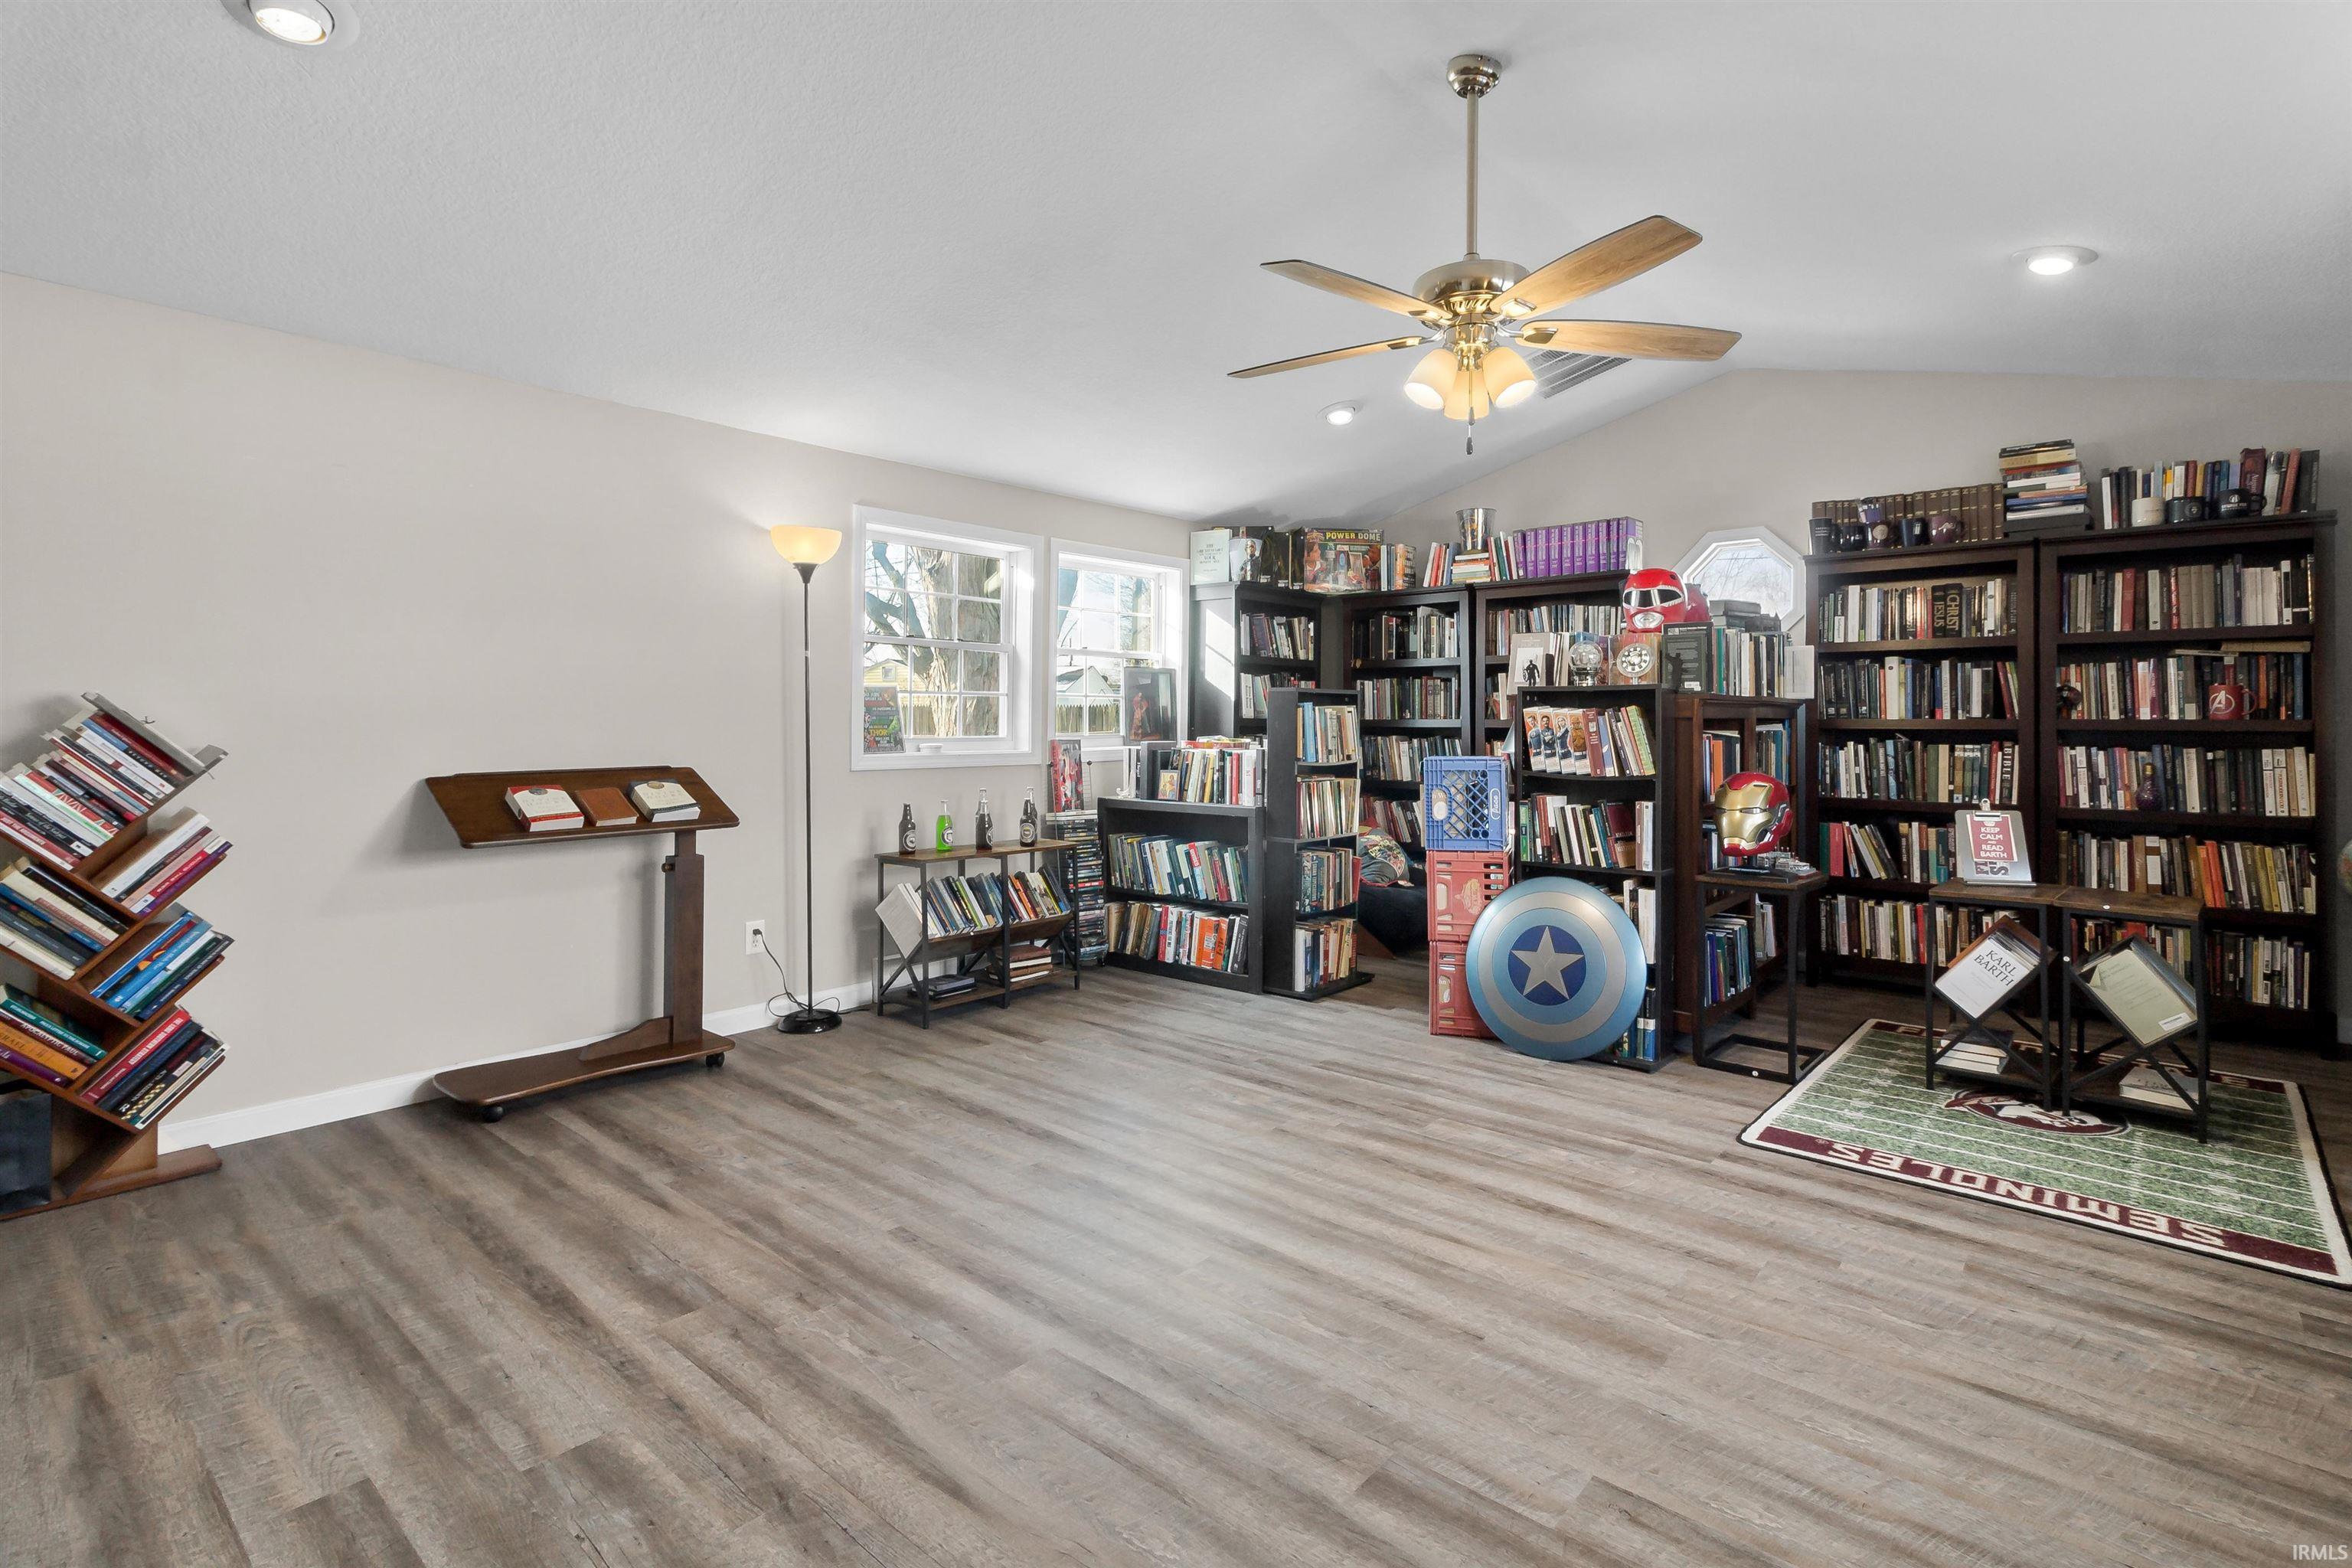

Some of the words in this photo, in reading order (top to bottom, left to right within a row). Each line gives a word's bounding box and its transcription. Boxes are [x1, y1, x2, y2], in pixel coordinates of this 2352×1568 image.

[1325, 531, 1355, 540] POWER
[1358, 532, 1381, 541] DOME
[1934, 602, 1943, 626] JESUS
[1946, 594, 1958, 630] CHRIST
[2003, 747, 2012, 779] BIBLE
[1974, 955, 2014, 986] BARTH
[1986, 950, 2017, 976] KARL
[21, 1022, 63, 1047] APOCALYPTIC
[62, 1042, 80, 1056] PAUL
[1828, 1142, 2228, 1248] SEMINOLES
